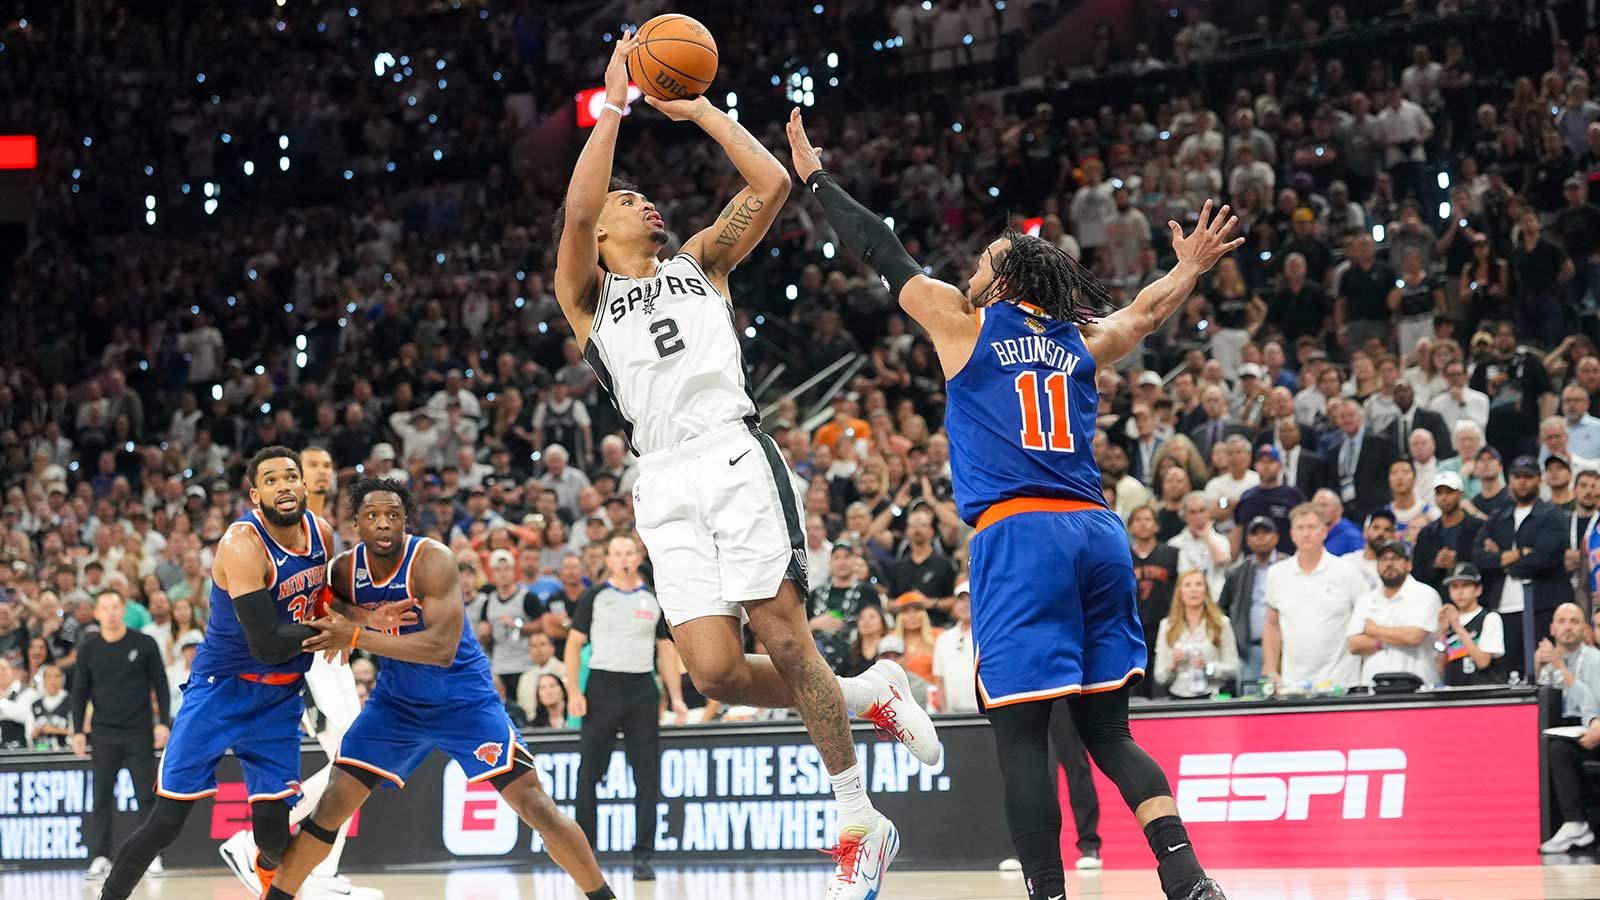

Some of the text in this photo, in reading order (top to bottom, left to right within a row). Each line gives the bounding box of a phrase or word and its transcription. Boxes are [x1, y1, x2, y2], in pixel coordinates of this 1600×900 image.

[655, 70, 700, 99] Wil
[716, 196, 763, 246] WAWG
[610, 275, 707, 324] SPURS
[649, 318, 687, 359] 2
[991, 336, 1080, 376] BRUNSON
[1015, 371, 1075, 453] 11
[277, 565, 326, 600] NEW YOR
[21, 770, 84, 814] ESPN
[660, 749, 708, 798] ON
[712, 747, 774, 796] THE
[1177, 748, 1407, 822] ESPN
[0, 816, 89, 860] WHERE.
[682, 801, 839, 851] ANYWHER
